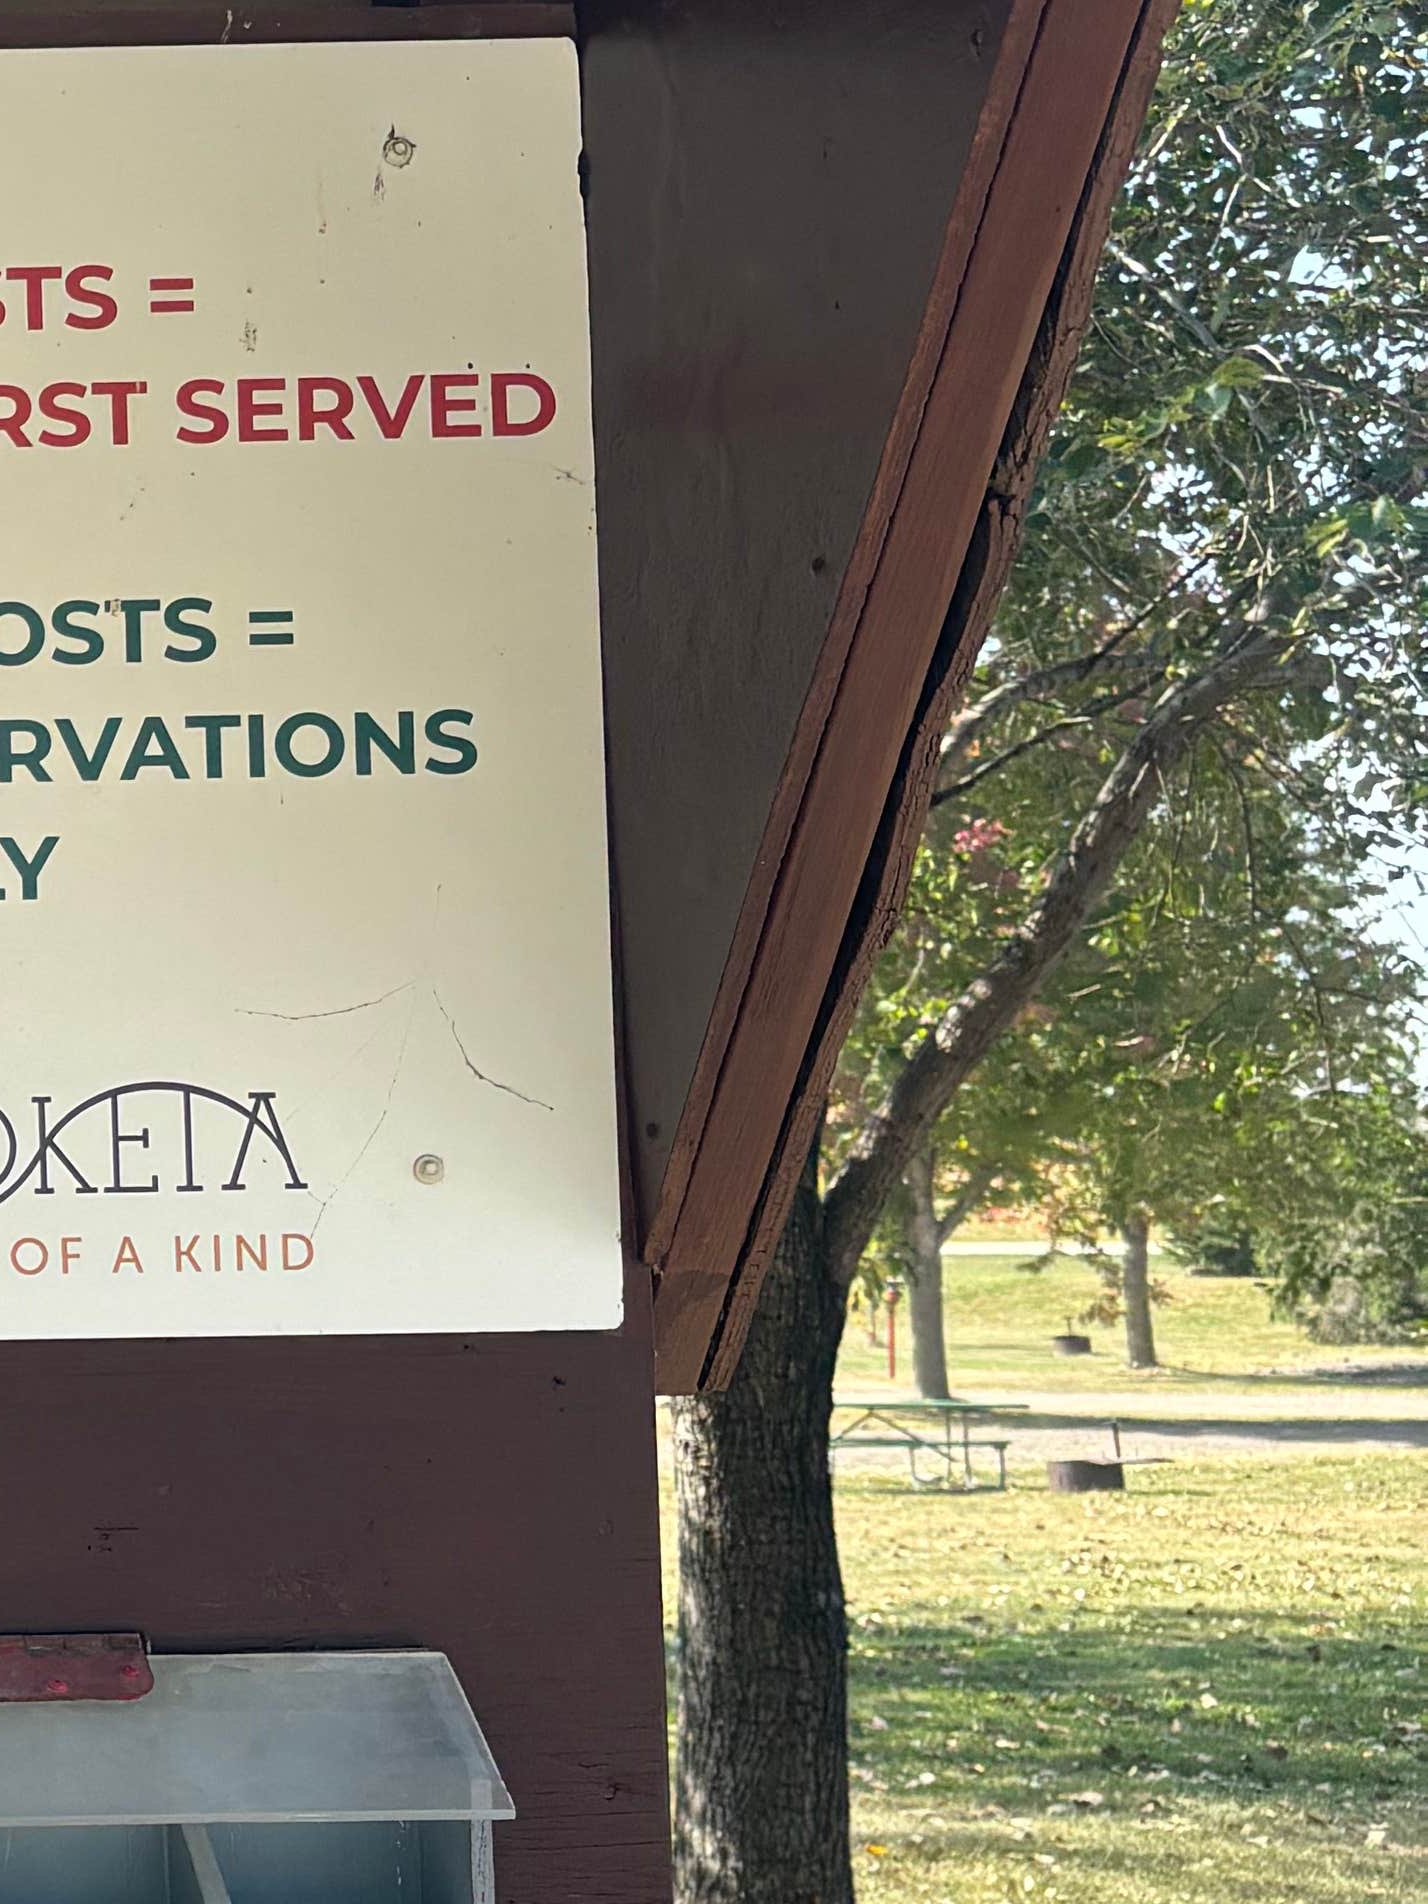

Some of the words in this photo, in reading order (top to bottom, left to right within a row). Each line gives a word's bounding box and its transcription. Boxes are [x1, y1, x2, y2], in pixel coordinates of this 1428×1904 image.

[177, 373, 556, 444] SERVED
[10, 1236, 83, 1275] OF
[112, 1235, 144, 1274] A
[174, 1233, 315, 1273] KIND
